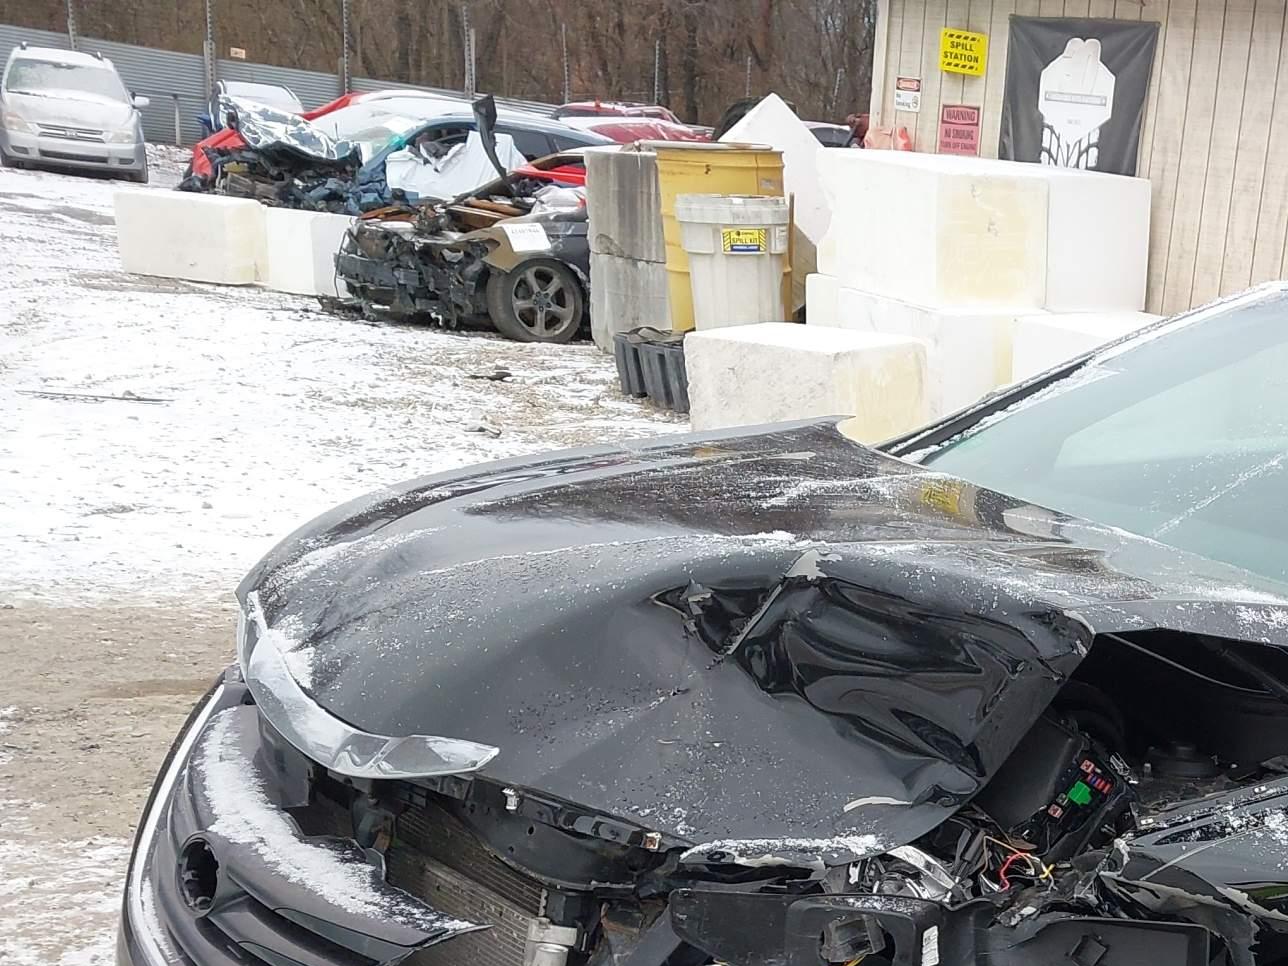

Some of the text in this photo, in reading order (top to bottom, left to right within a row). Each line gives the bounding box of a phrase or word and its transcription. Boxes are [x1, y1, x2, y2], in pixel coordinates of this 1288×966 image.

[950, 40, 974, 52] SPILL
[943, 51, 979, 63] STATION
[946, 110, 977, 122] WARNING
